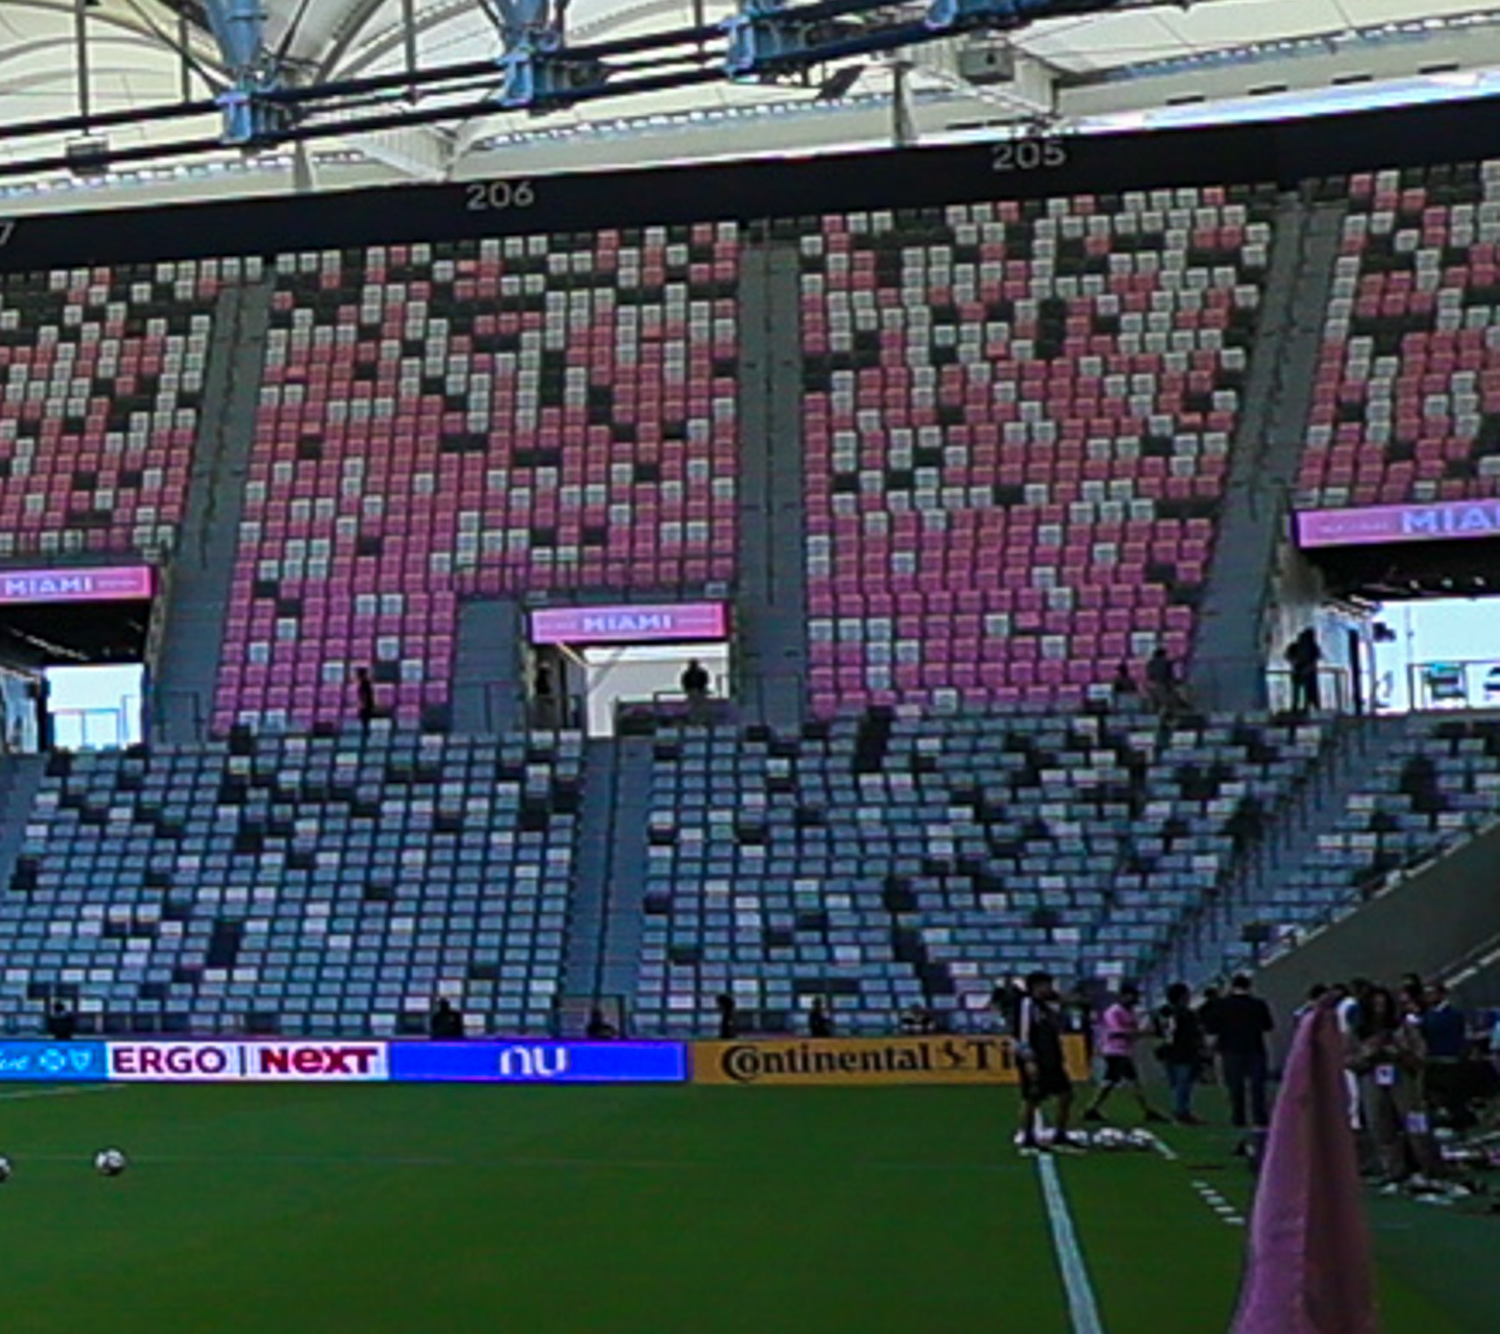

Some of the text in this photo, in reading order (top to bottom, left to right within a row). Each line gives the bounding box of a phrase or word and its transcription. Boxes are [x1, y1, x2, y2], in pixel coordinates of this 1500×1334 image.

[993, 143, 1065, 170] 205
[467, 182, 534, 210] 206
[5, 577, 92, 595] MIAMI
[583, 614, 671, 631] MIAMI
[112, 1045, 226, 1074] ERGO
[722, 1041, 931, 1080] Continental
